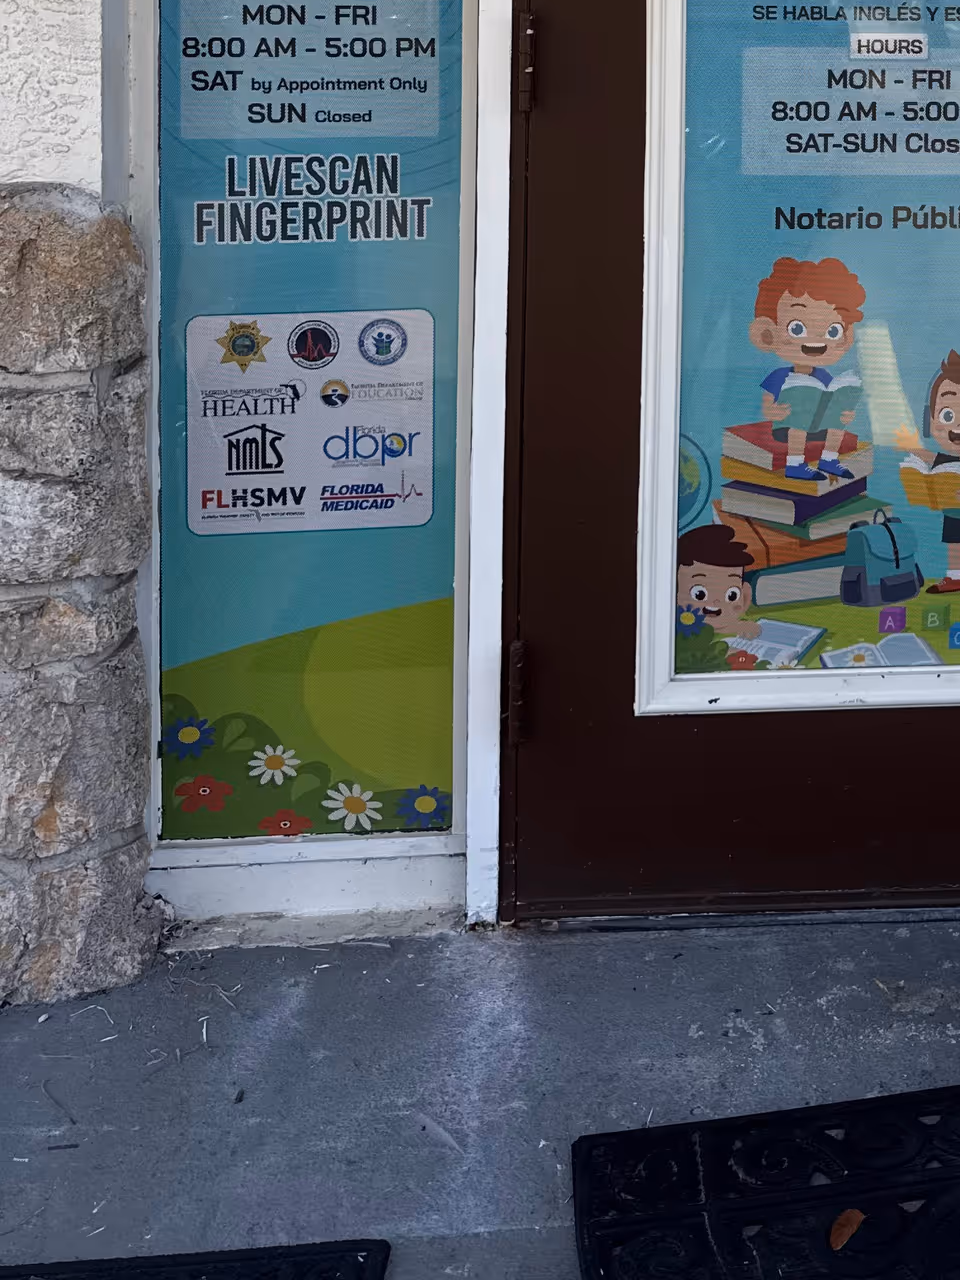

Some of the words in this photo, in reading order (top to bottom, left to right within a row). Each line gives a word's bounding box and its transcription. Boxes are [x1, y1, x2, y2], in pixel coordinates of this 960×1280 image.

[242, 4, 306, 26] MON
[335, 5, 377, 26] FRI
[752, 5, 777, 21] SE
[783, 5, 847, 21] HABLA
[853, 1, 921, 22] INGLÉS
[926, 6, 939, 21] Y
[182, 37, 245, 58] 8:00
[254, 37, 296, 58] AM
[325, 37, 386, 58] 5:00
[396, 38, 436, 58] PM
[857, 39, 923, 55] HOURS
[191, 70, 243, 91] SAT
[251, 78, 272, 94] by
[277, 77, 385, 94] Appointment
[389, 77, 428, 93] Only
[827, 69, 886, 89] MON
[912, 70, 952, 90] FRI
[247, 103, 306, 124] SUN
[314, 110, 372, 123] Closed
[771, 101, 830, 122] 8:00
[837, 101, 877, 122] AM
[903, 101, 959, 122] 5:00
[785, 133, 897, 153] SAT-SUN
[225, 154, 399, 198] LIVESCAN
[194, 197, 432, 245] FINGERPRINT
[775, 206, 882, 230] Notario
[201, 397, 297, 417] HEALTH
[356, 425, 386, 434] Florida
[323, 426, 421, 466] dbpr
[201, 486, 306, 509] FLHSMV
[321, 483, 384, 496] FLORIDA
[321, 498, 395, 512] MEDICAID
[885, 616, 895, 630] A
[927, 613, 939, 627] B
